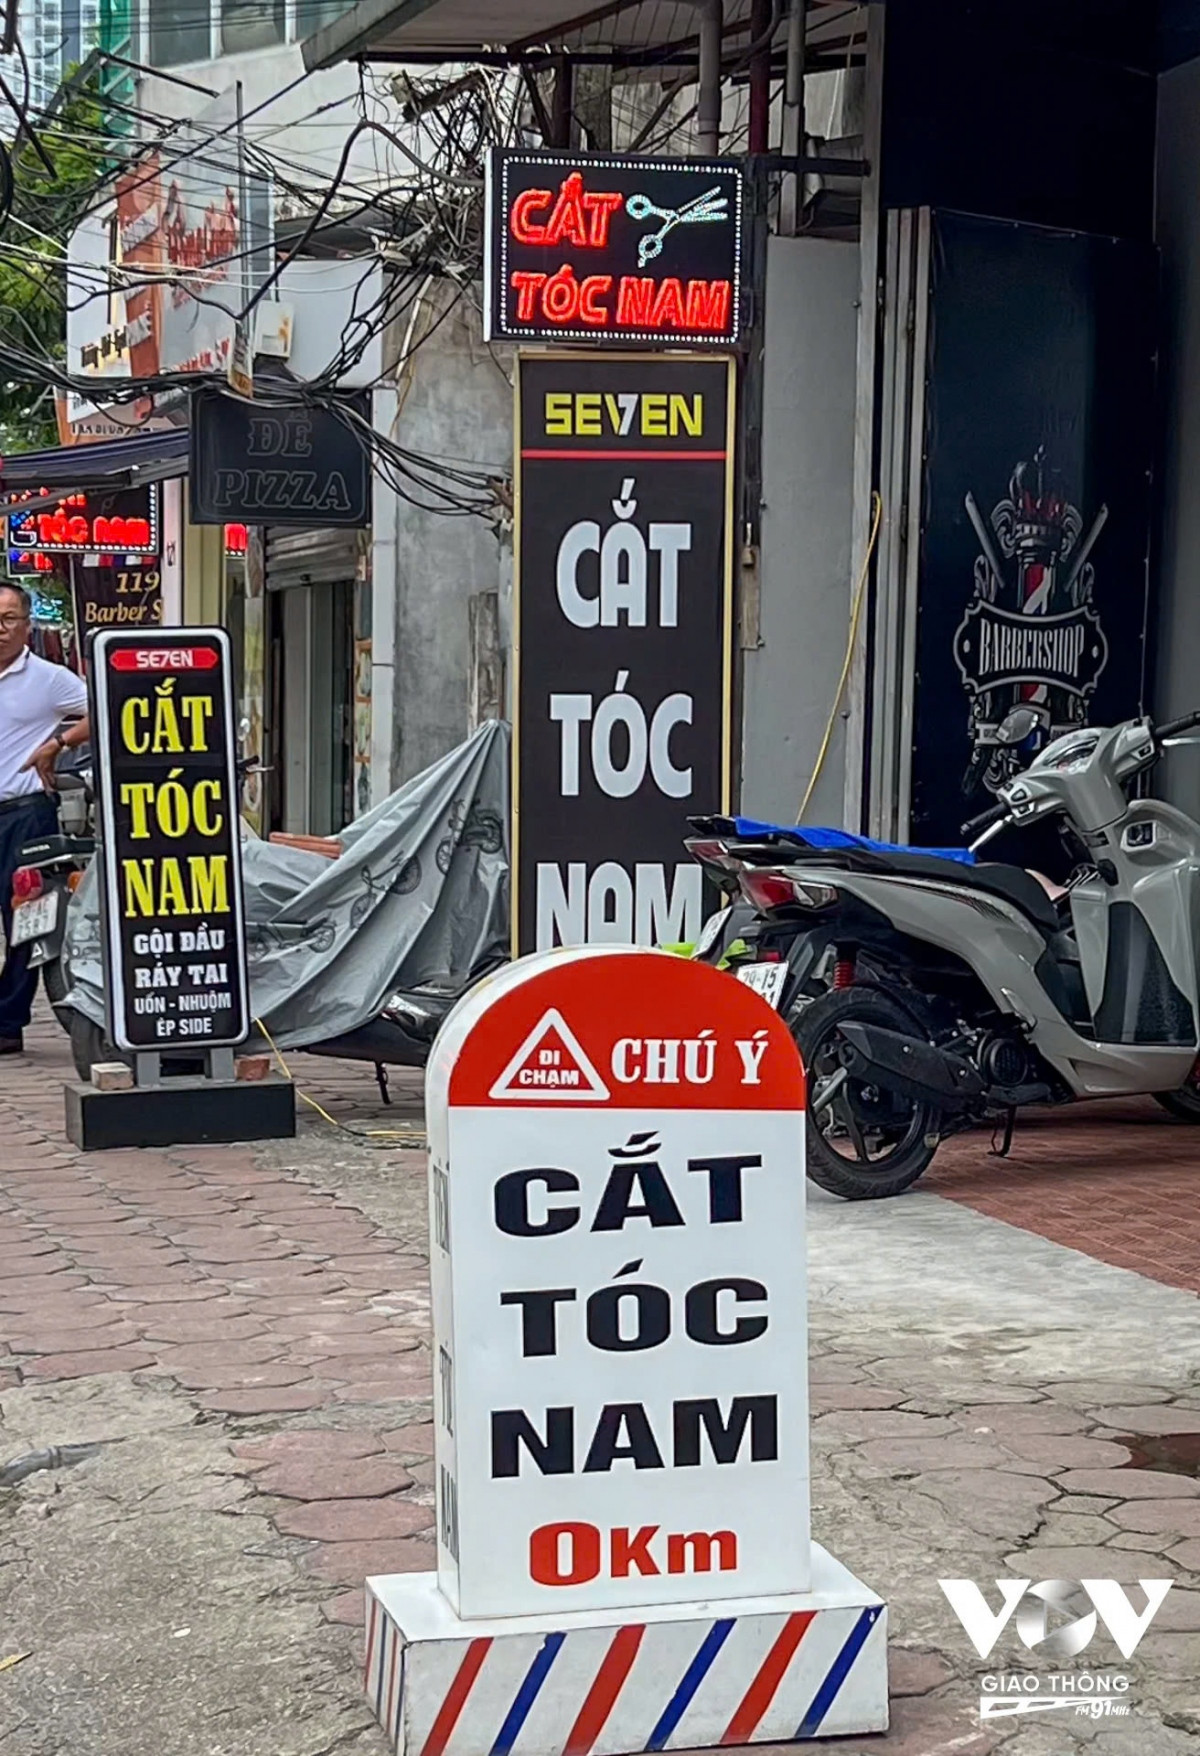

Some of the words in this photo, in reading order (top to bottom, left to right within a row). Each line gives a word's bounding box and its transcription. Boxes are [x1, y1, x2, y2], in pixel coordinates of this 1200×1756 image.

[511, 263, 613, 324] TÓC
[616, 276, 730, 329] NAM
[213, 468, 351, 510] PIZZA
[556, 477, 692, 629] CẮT
[85, 601, 148, 623] Barber
[978, 618, 1085, 678] BARBERSHOP
[120, 677, 213, 755] CẮT
[549, 669, 694, 799] TÓC
[120, 768, 223, 838] TÓC
[121, 855, 231, 917] NAM
[536, 861, 703, 952] NAM
[133, 927, 175, 959] GỘI
[179, 921, 226, 952] ĐẦU
[134, 961, 182, 989] RÁY
[187, 963, 228, 986] TAI
[134, 991, 166, 1015] UỐN
[178, 989, 232, 1014] NHUỘM
[179, 1017, 213, 1035] SIDE
[611, 1028, 718, 1084] CHÚ
[734, 1029, 770, 1085] Ý
[518, 1068, 580, 1089] CHẠM
[538, 1050, 560, 1067] ĐI
[493, 1129, 763, 1238] CẮT
[499, 1257, 769, 1359] TÓC
[490, 1393, 779, 1480] NAM
